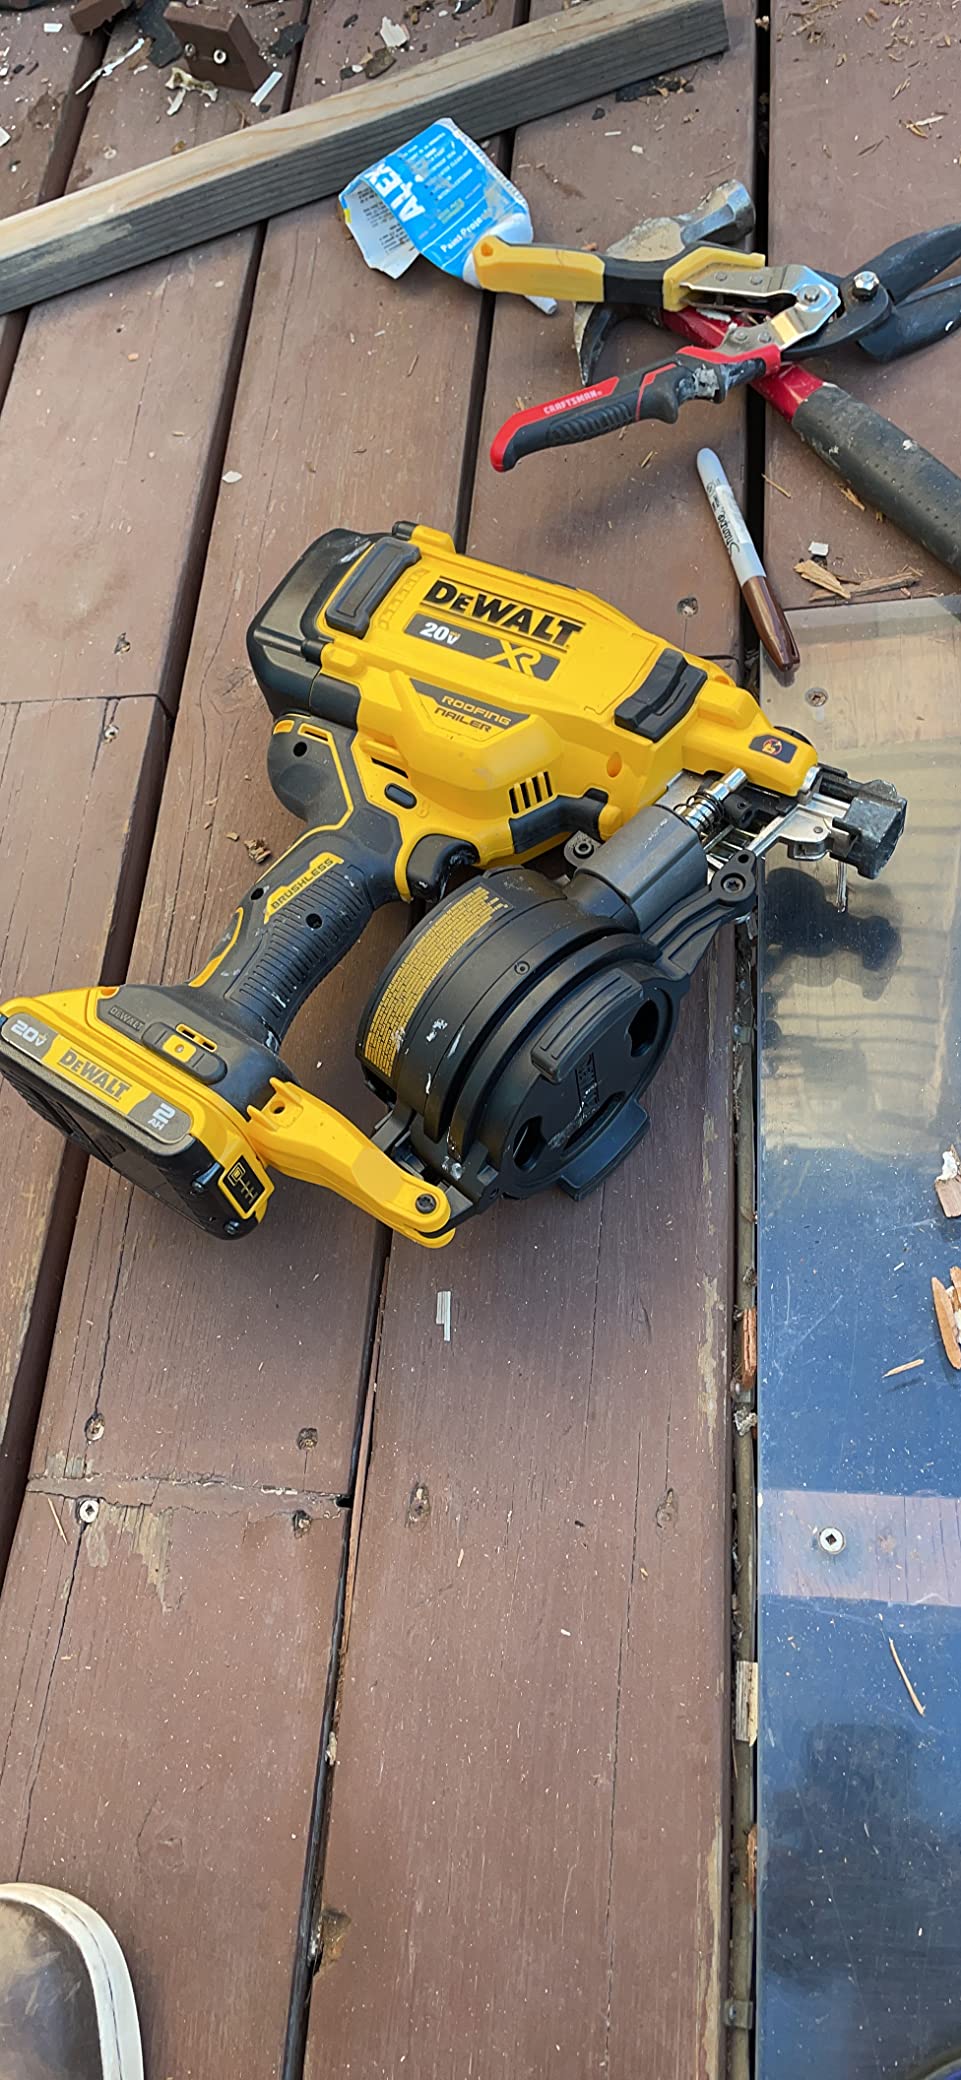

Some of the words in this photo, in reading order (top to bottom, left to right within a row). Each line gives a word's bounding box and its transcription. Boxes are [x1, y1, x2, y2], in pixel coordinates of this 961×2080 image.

[364, 163, 426, 222] ALEX
[440, 234, 463, 253] Paint
[543, 389, 599, 415] CRAFTSMAN
[423, 580, 584, 646] DEWALT
[484, 640, 541, 677] XR
[434, 707, 492, 732] NAILER
[442, 696, 511, 726] ROOFING
[271, 858, 333, 909] BRUSHLESS
[109, 1005, 145, 1031] DEWALT
[58, 1050, 130, 1099] DEWALT
[147, 1118, 165, 1131] AH
[152, 1103, 176, 1124] 2
